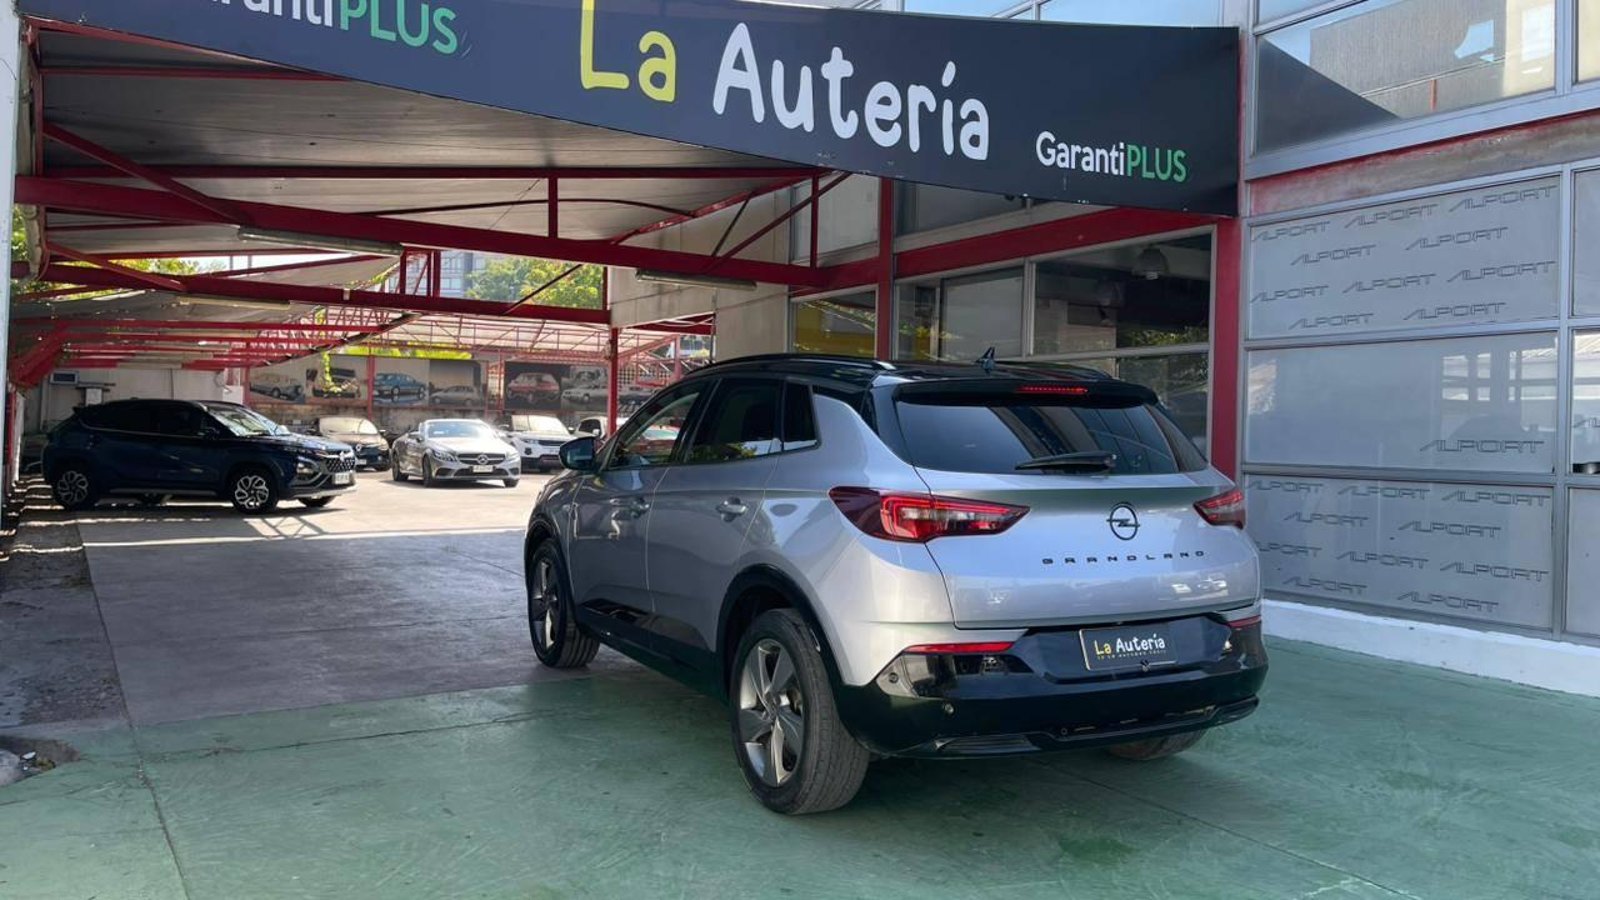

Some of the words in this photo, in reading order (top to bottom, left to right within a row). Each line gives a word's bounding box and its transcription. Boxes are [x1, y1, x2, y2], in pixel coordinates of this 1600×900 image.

[581, 0, 675, 102] La
[713, 22, 989, 161] Autería
[1035, 130, 1187, 182] GarantiPLUS
[1042, 550, 1204, 565] GRANDLAND
[1254, 541, 1323, 558] LPORT
[1094, 639, 1112, 655] La
